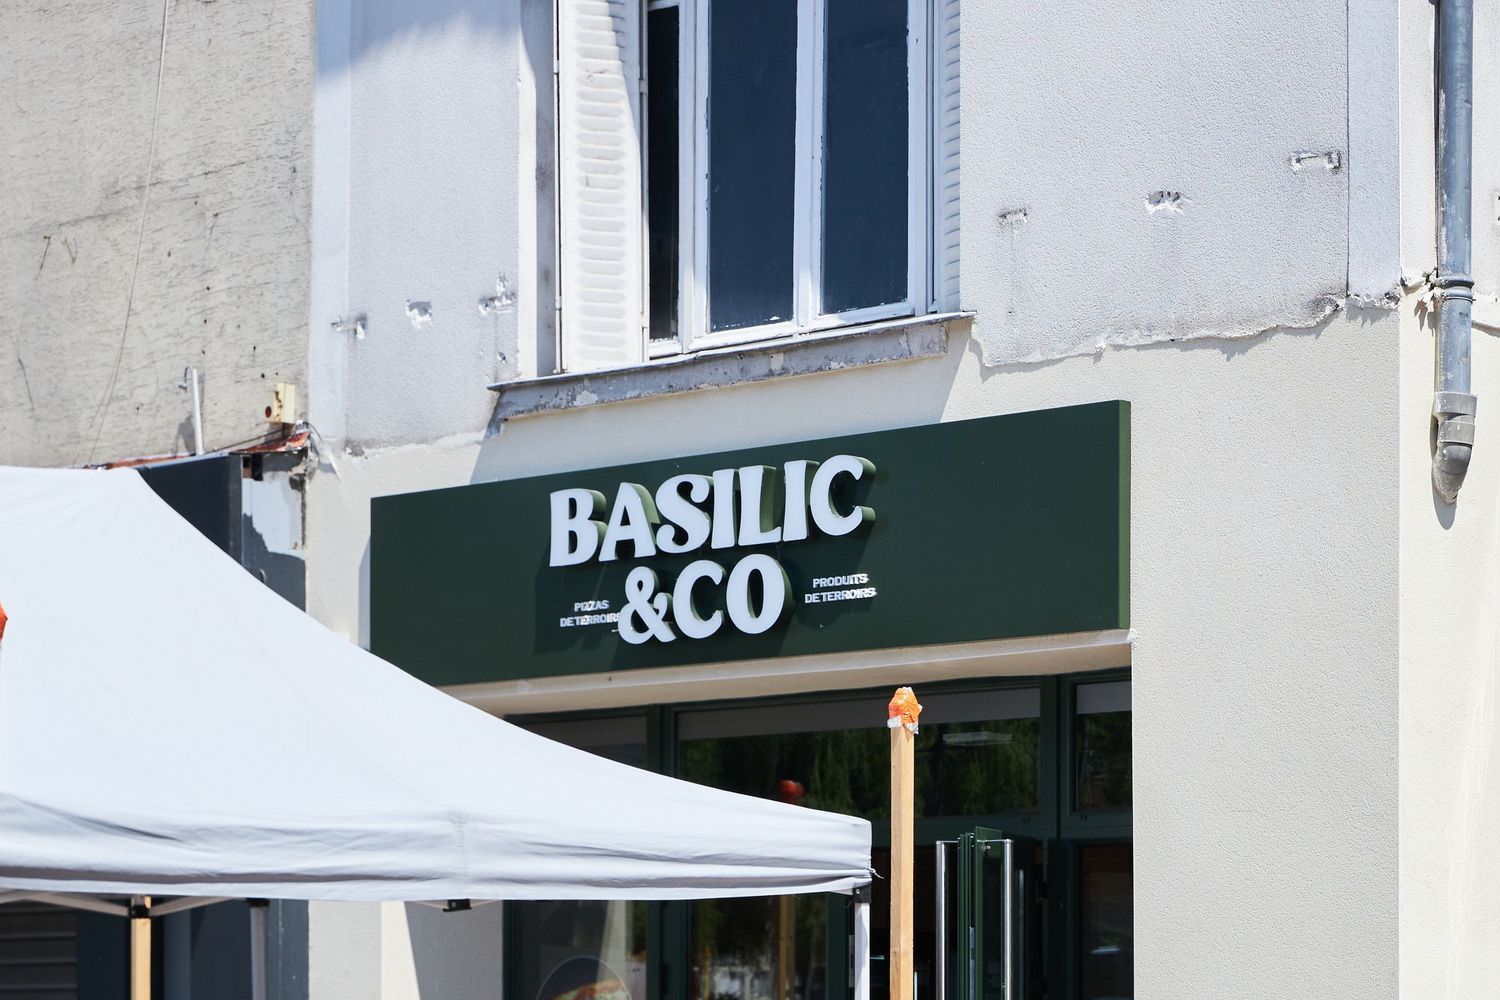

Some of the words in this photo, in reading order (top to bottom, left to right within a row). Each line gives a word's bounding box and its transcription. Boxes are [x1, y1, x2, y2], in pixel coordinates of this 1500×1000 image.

[548, 454, 873, 567] BASILIC
[574, 600, 609, 612] PIZZAS
[617, 553, 788, 645] &CO
[812, 573, 868, 588] PRODUITS
